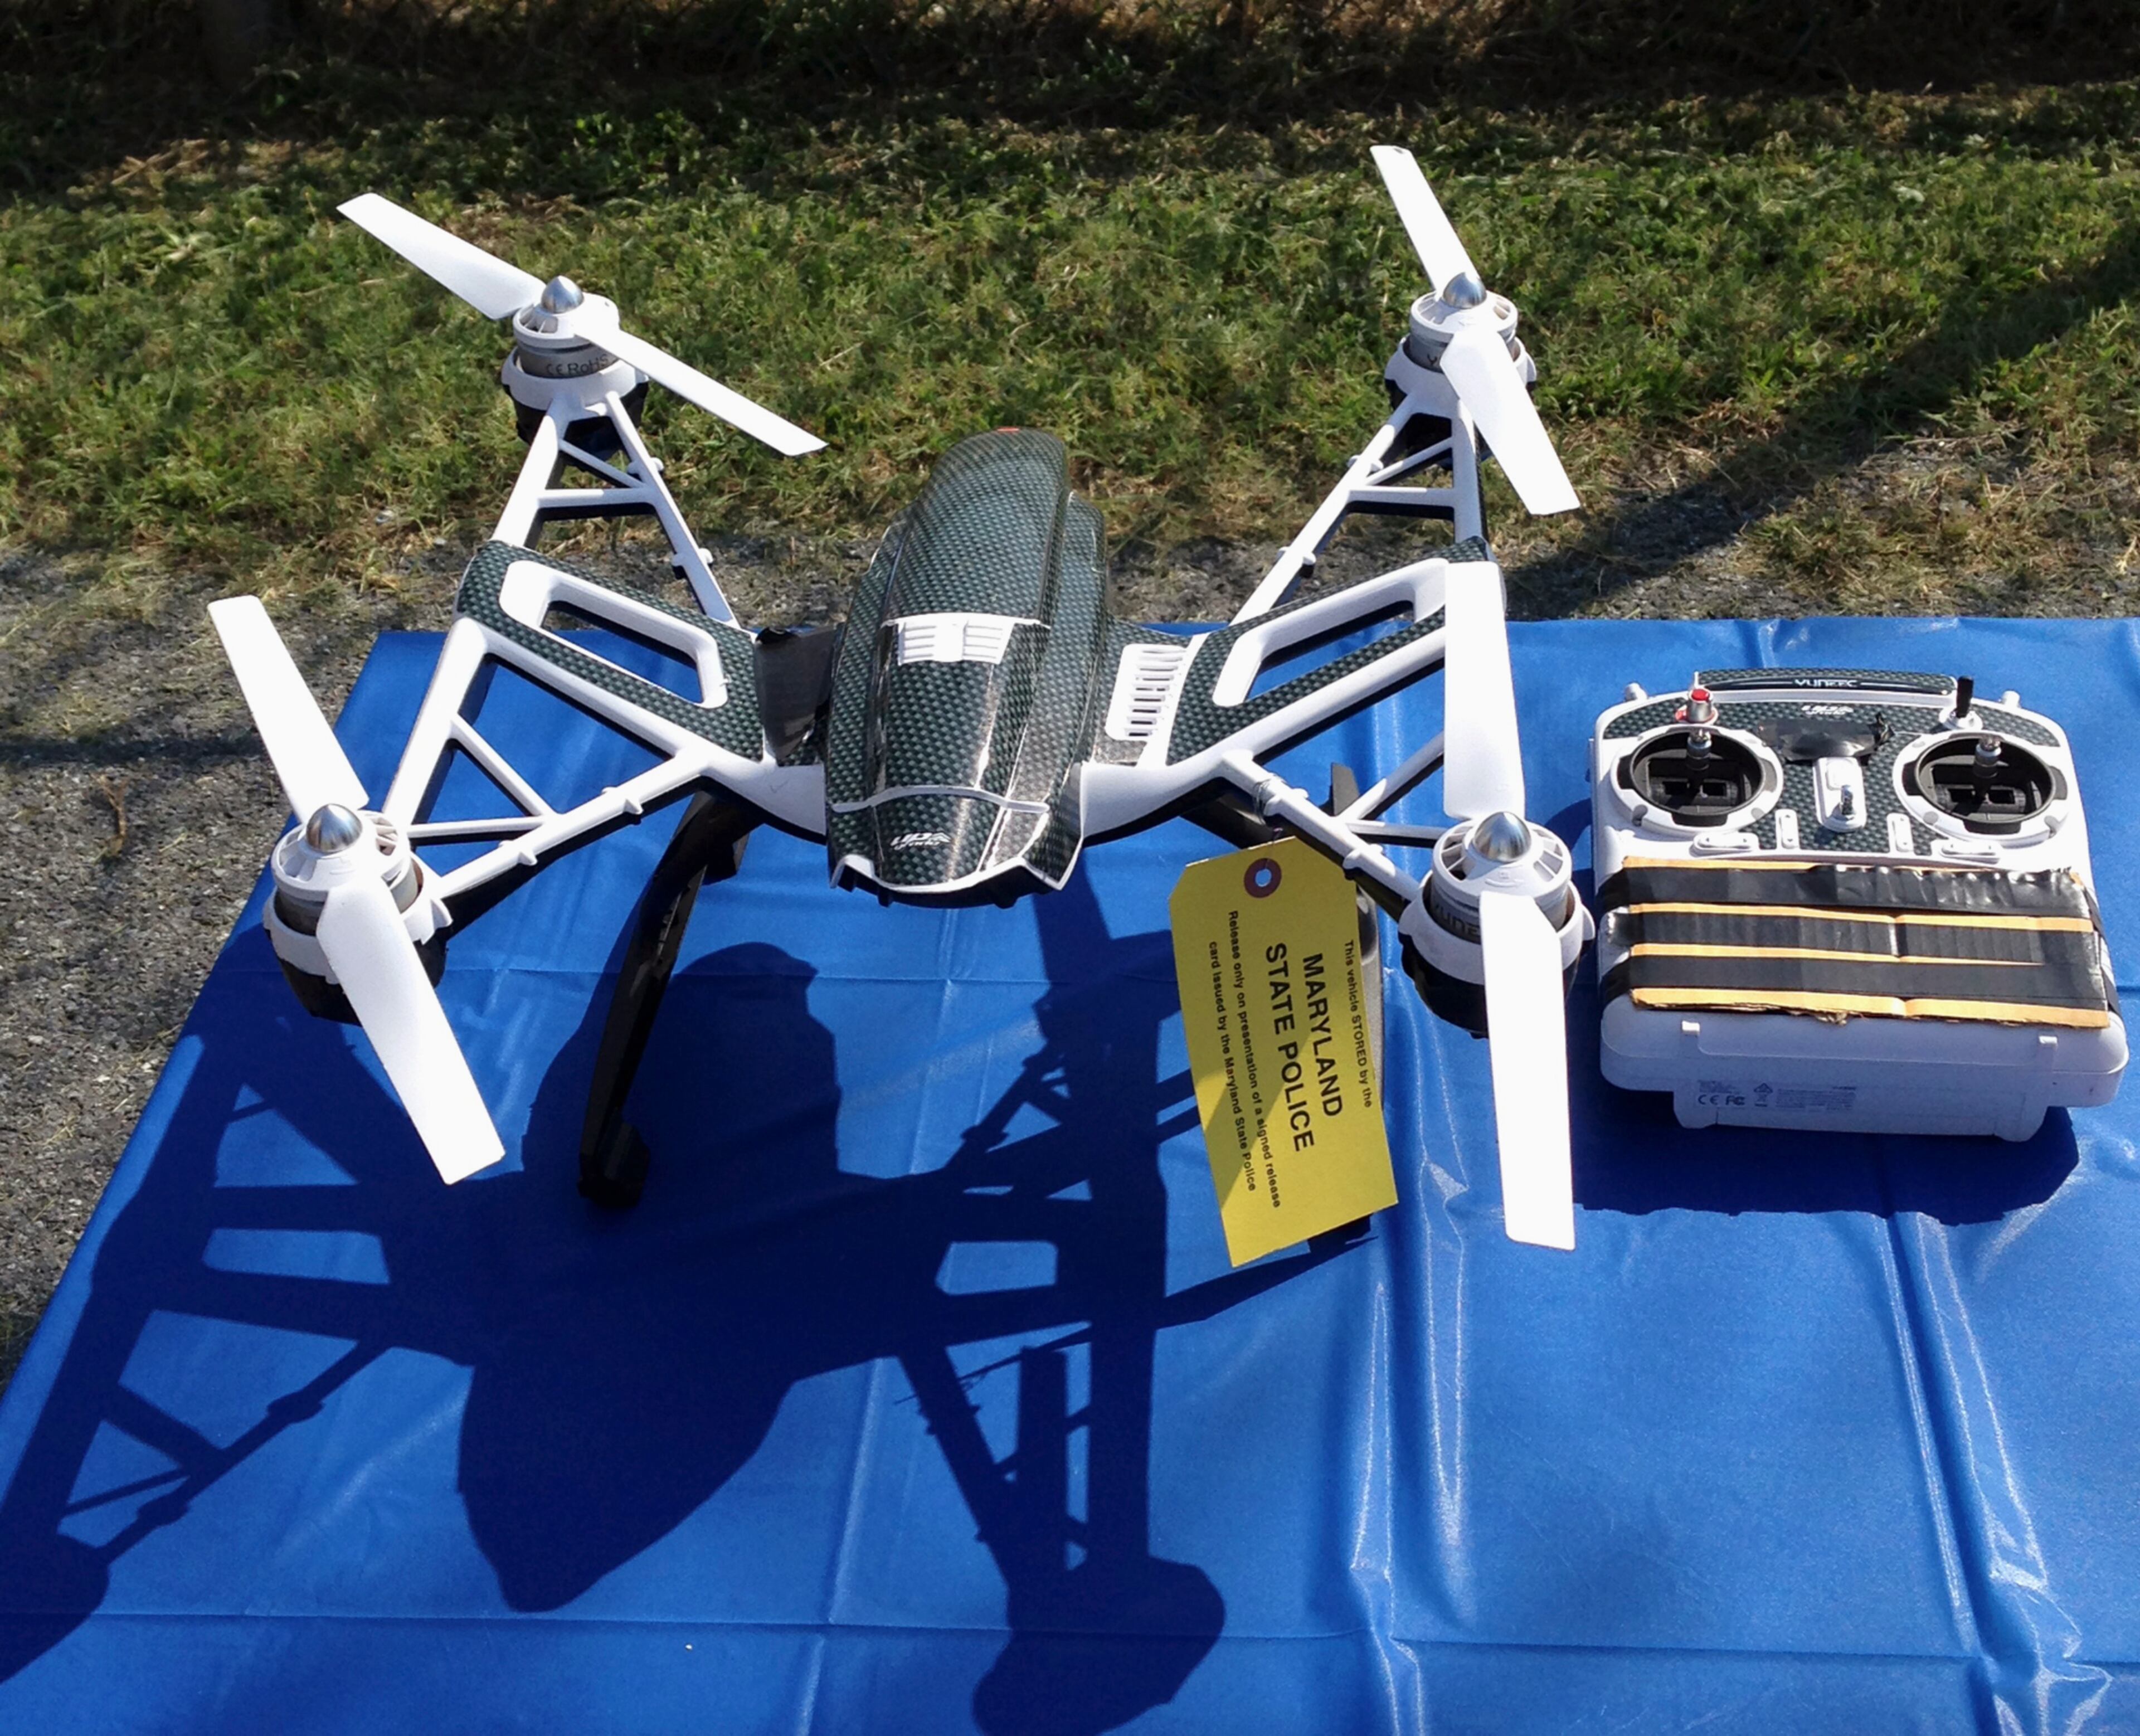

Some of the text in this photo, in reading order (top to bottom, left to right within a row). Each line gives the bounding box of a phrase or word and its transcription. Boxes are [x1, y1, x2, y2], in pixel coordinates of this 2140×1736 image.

[567, 353, 609, 375] RoHS
[1209, 941, 1256, 1192] card issued by the Maryland State Police
[1228, 910, 1281, 1208] Release only on presentation of a signed release
[1266, 942, 1315, 1152] STATE POLICE
[1302, 952, 1343, 1117] MARYLAND
[1345, 939, 1373, 1108] This vehicle STORED by the
